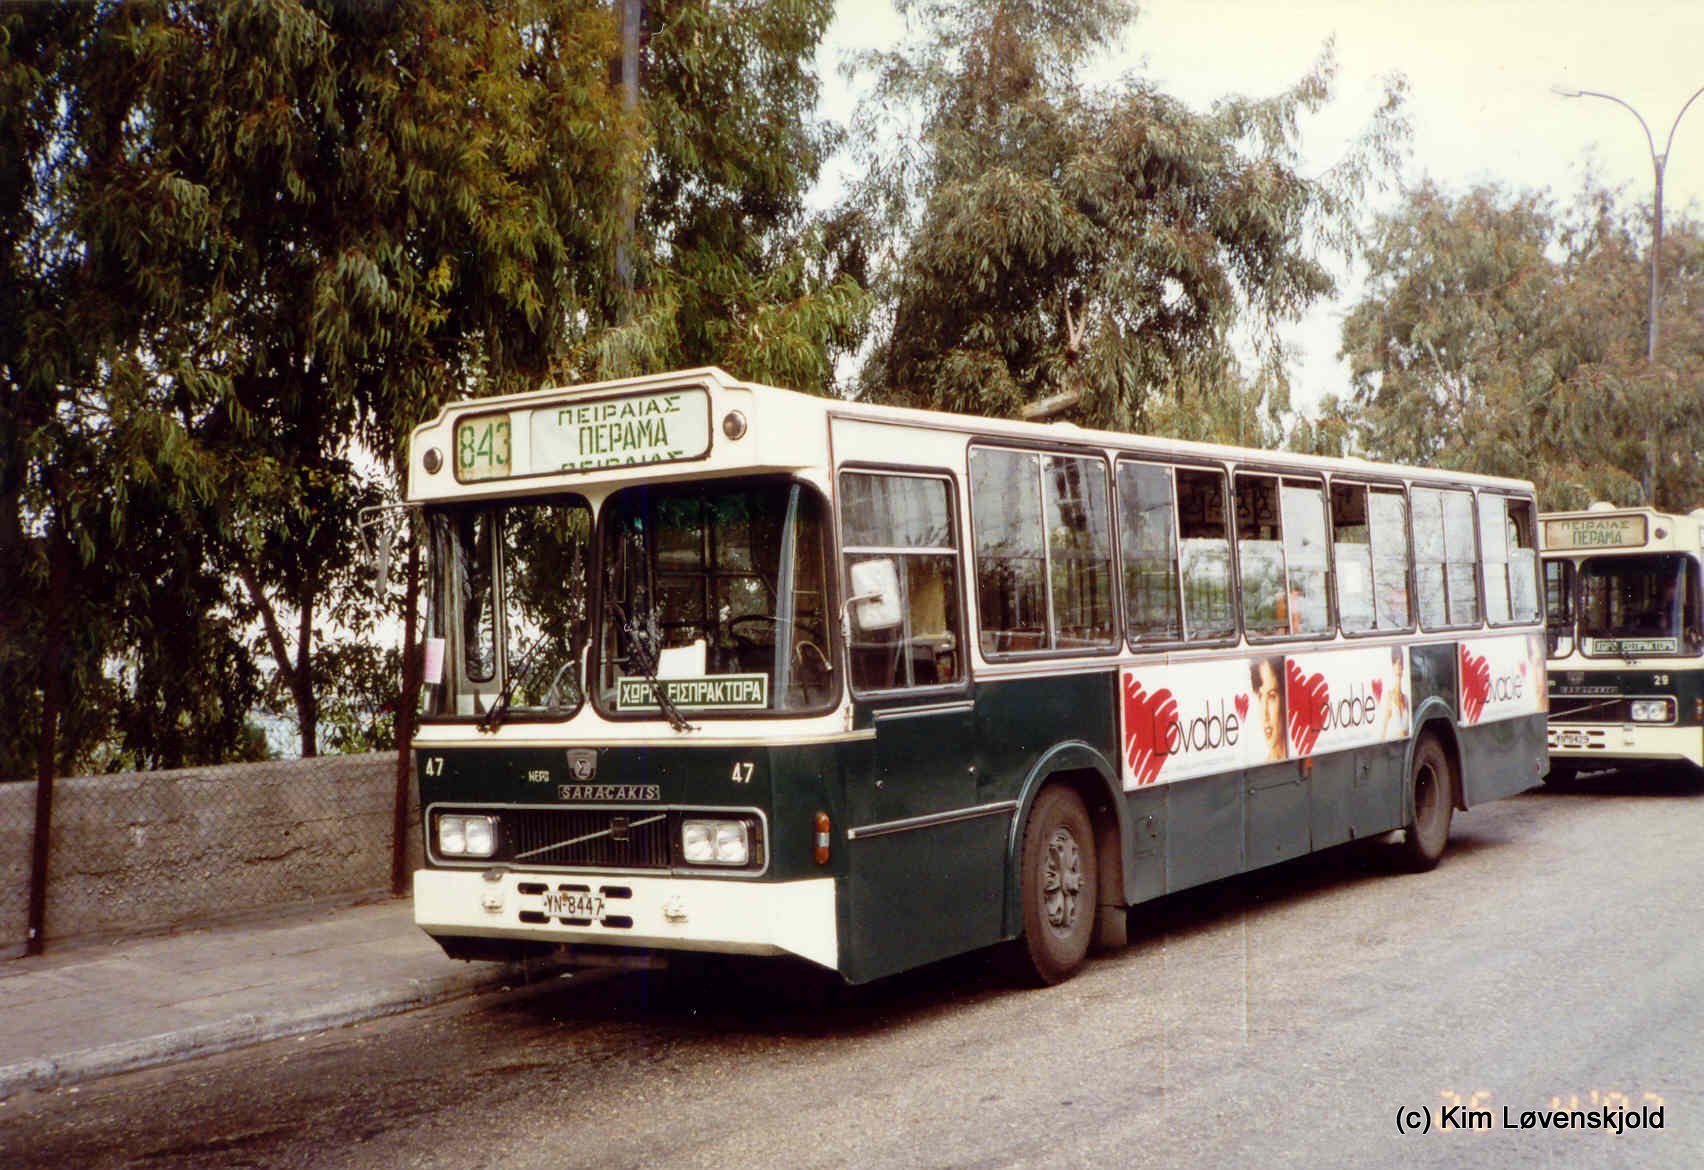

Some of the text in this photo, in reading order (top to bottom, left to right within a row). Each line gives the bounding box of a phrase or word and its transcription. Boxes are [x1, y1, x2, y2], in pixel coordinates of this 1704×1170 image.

[558, 395, 681, 426] ΠΕΙΡΑΙΑΣ
[460, 422, 511, 468] 843
[579, 417, 668, 455] ΠΕΡΑΜΑ
[1309, 682, 1376, 733] Lovable
[1152, 697, 1239, 757] Lovable
[425, 757, 444, 777] 47
[731, 762, 755, 783] 47
[561, 785, 657, 801] SARACAKIS
